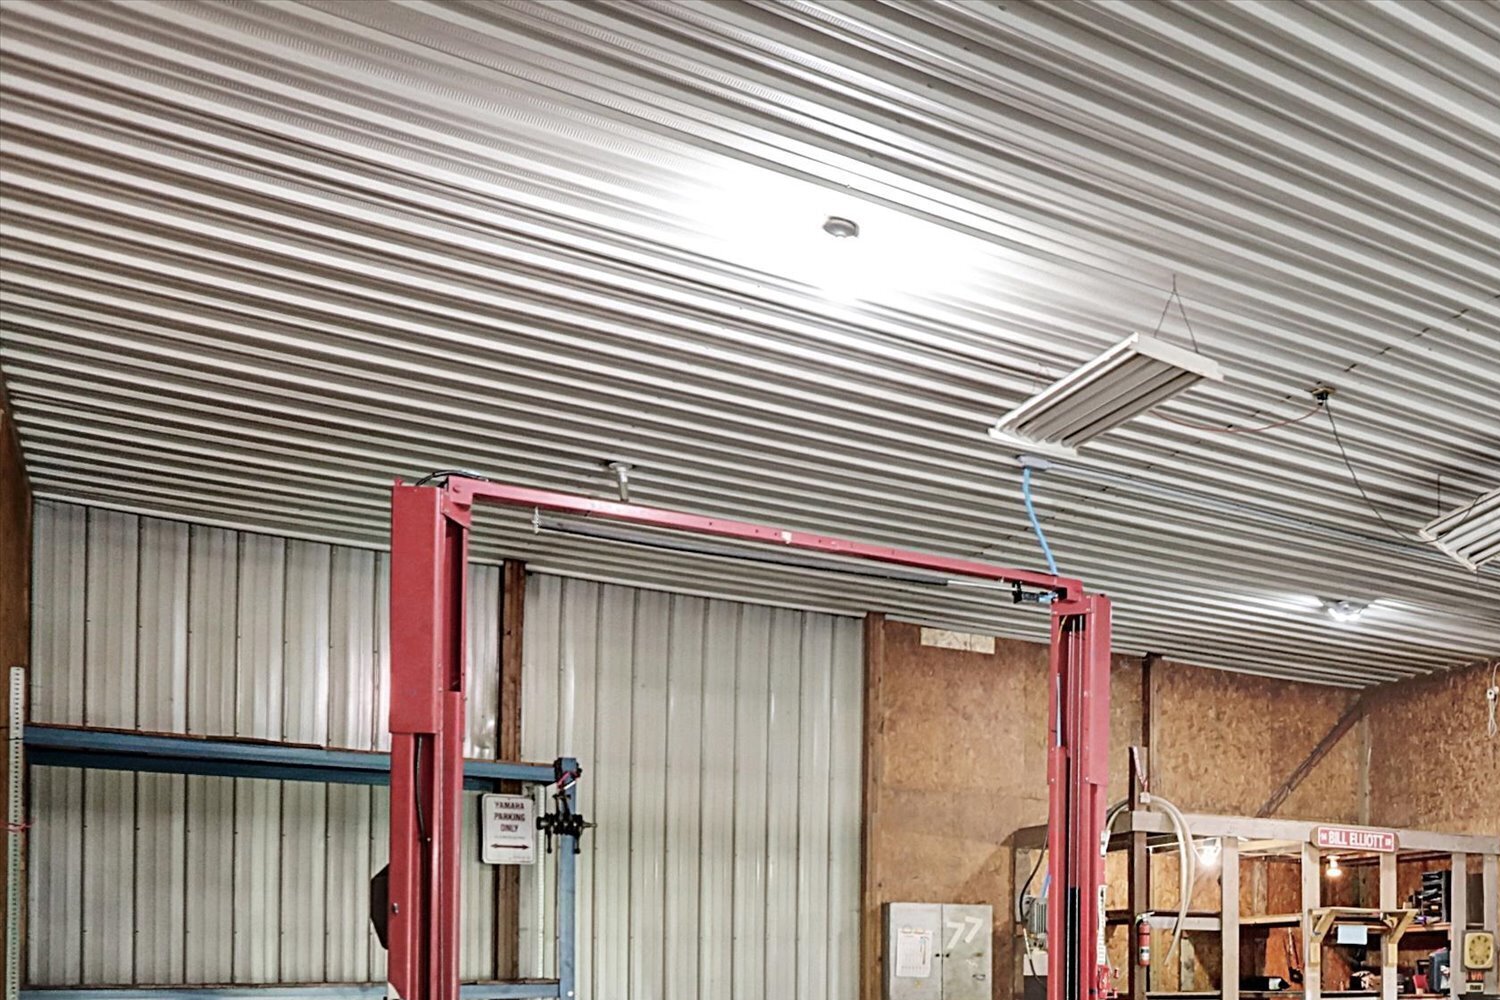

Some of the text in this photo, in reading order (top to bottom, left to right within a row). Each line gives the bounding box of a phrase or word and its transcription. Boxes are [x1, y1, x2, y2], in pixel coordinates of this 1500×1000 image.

[494, 812, 526, 822] PARKING
[500, 824, 518, 832] ONLY
[1328, 830, 1348, 845] BILL
[1350, 832, 1385, 848] ELLIOTT
